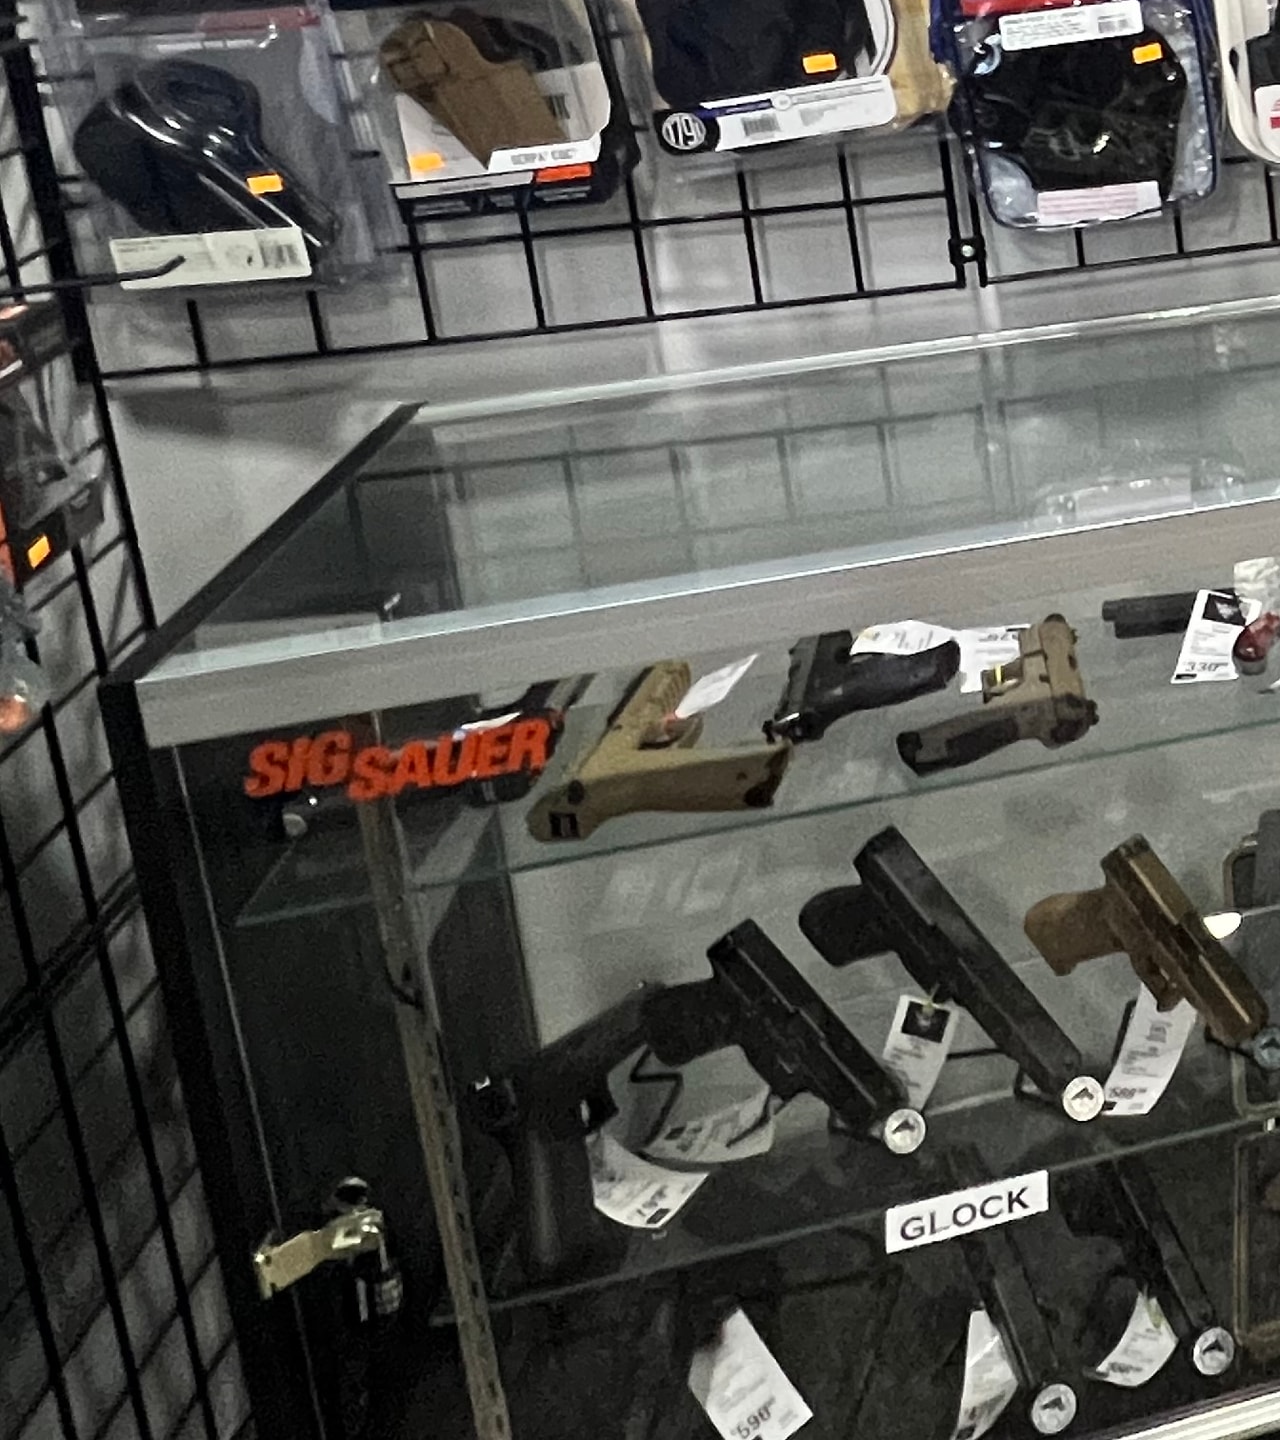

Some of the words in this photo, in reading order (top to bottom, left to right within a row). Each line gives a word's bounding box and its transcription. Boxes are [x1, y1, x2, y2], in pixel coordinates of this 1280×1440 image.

[245, 731, 352, 799] SIG
[346, 718, 552, 803] SAUER
[900, 1186, 1031, 1242] GLOCK
